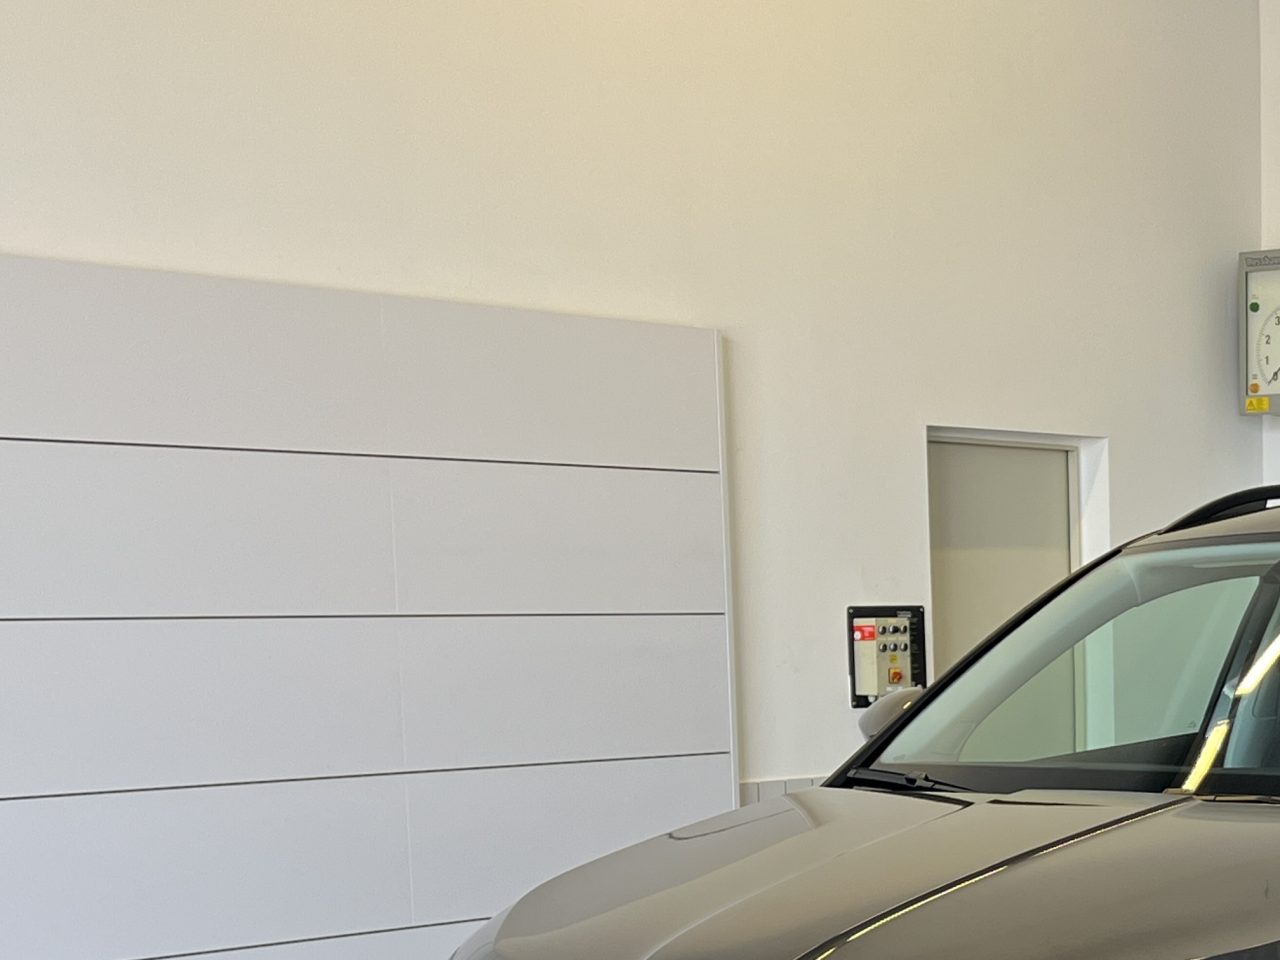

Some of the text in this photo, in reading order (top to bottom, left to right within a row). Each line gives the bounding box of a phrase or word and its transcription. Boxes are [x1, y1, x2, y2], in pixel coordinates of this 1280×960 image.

[1274, 315, 1280, 326] 3
[1265, 334, 1271, 345] 2
[1265, 355, 1269, 365] 1
